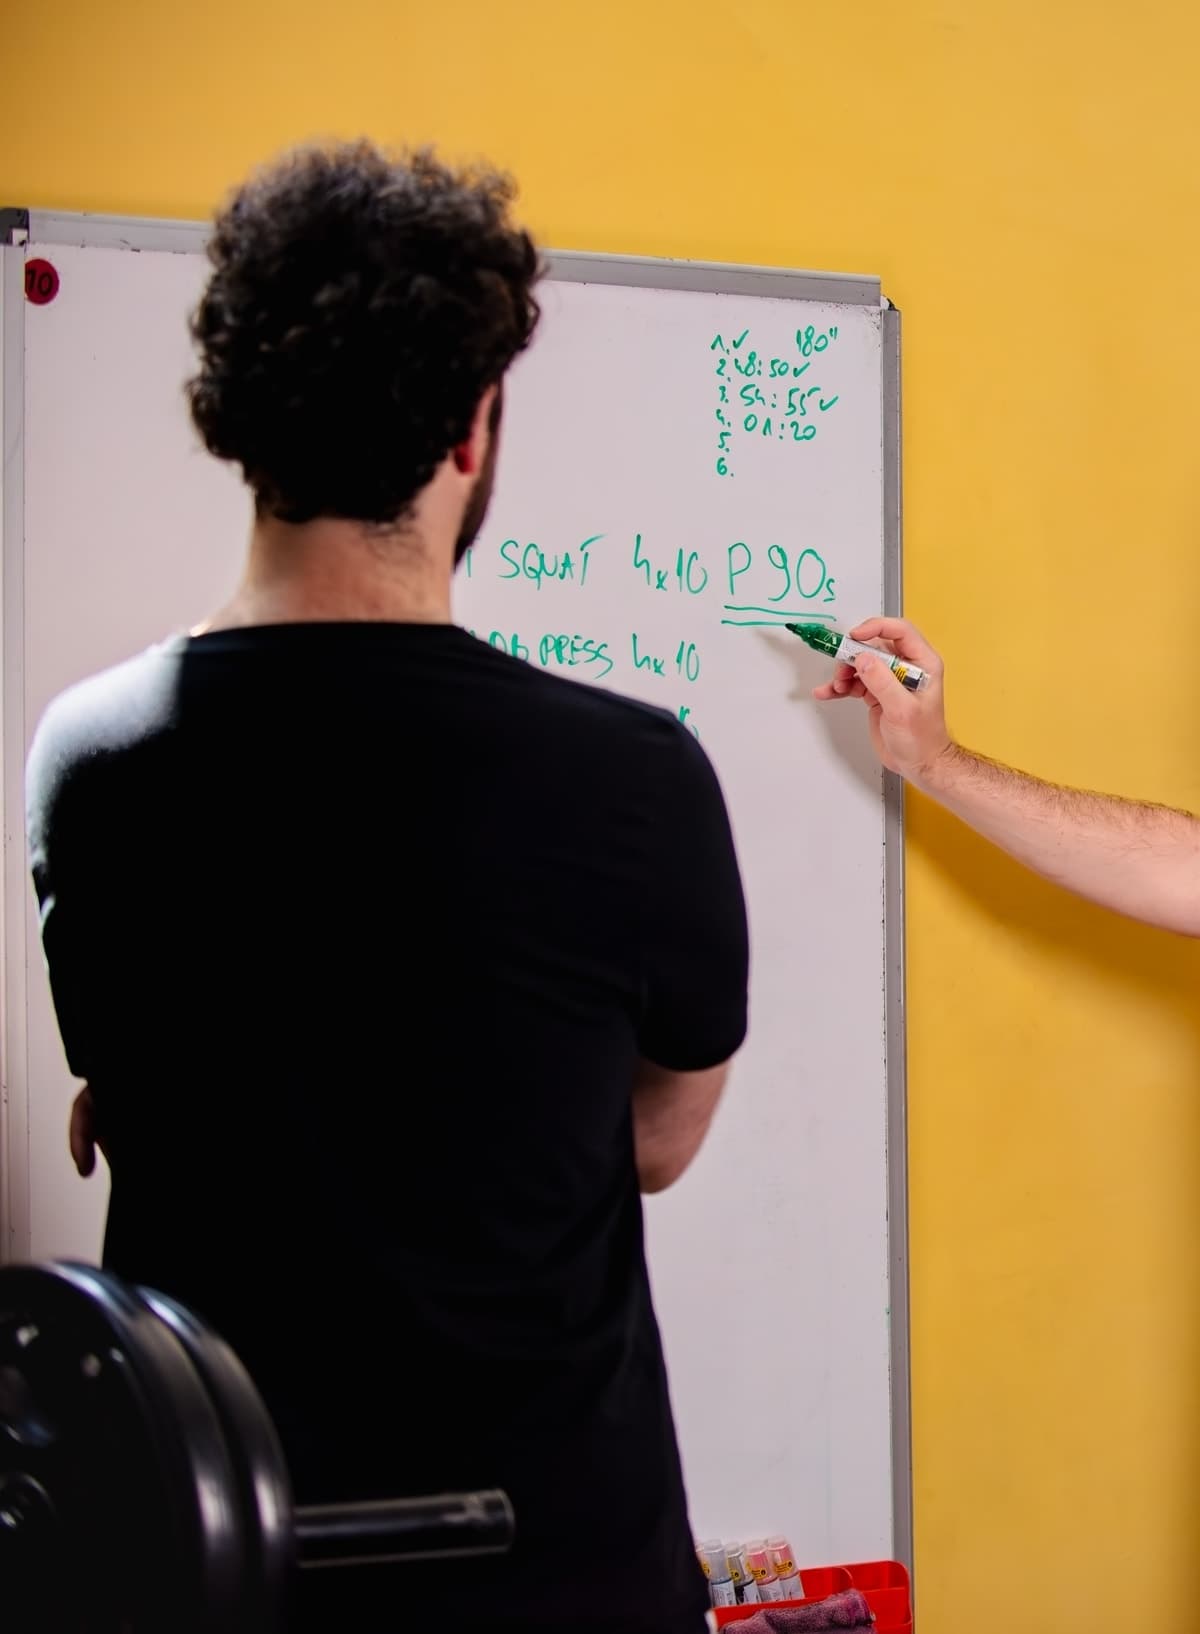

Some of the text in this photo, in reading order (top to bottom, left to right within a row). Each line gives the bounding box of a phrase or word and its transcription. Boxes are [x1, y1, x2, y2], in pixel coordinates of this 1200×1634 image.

[26, 268, 54, 296] 10
[498, 534, 605, 590] SQUAT
[539, 634, 614, 680] PRESS
